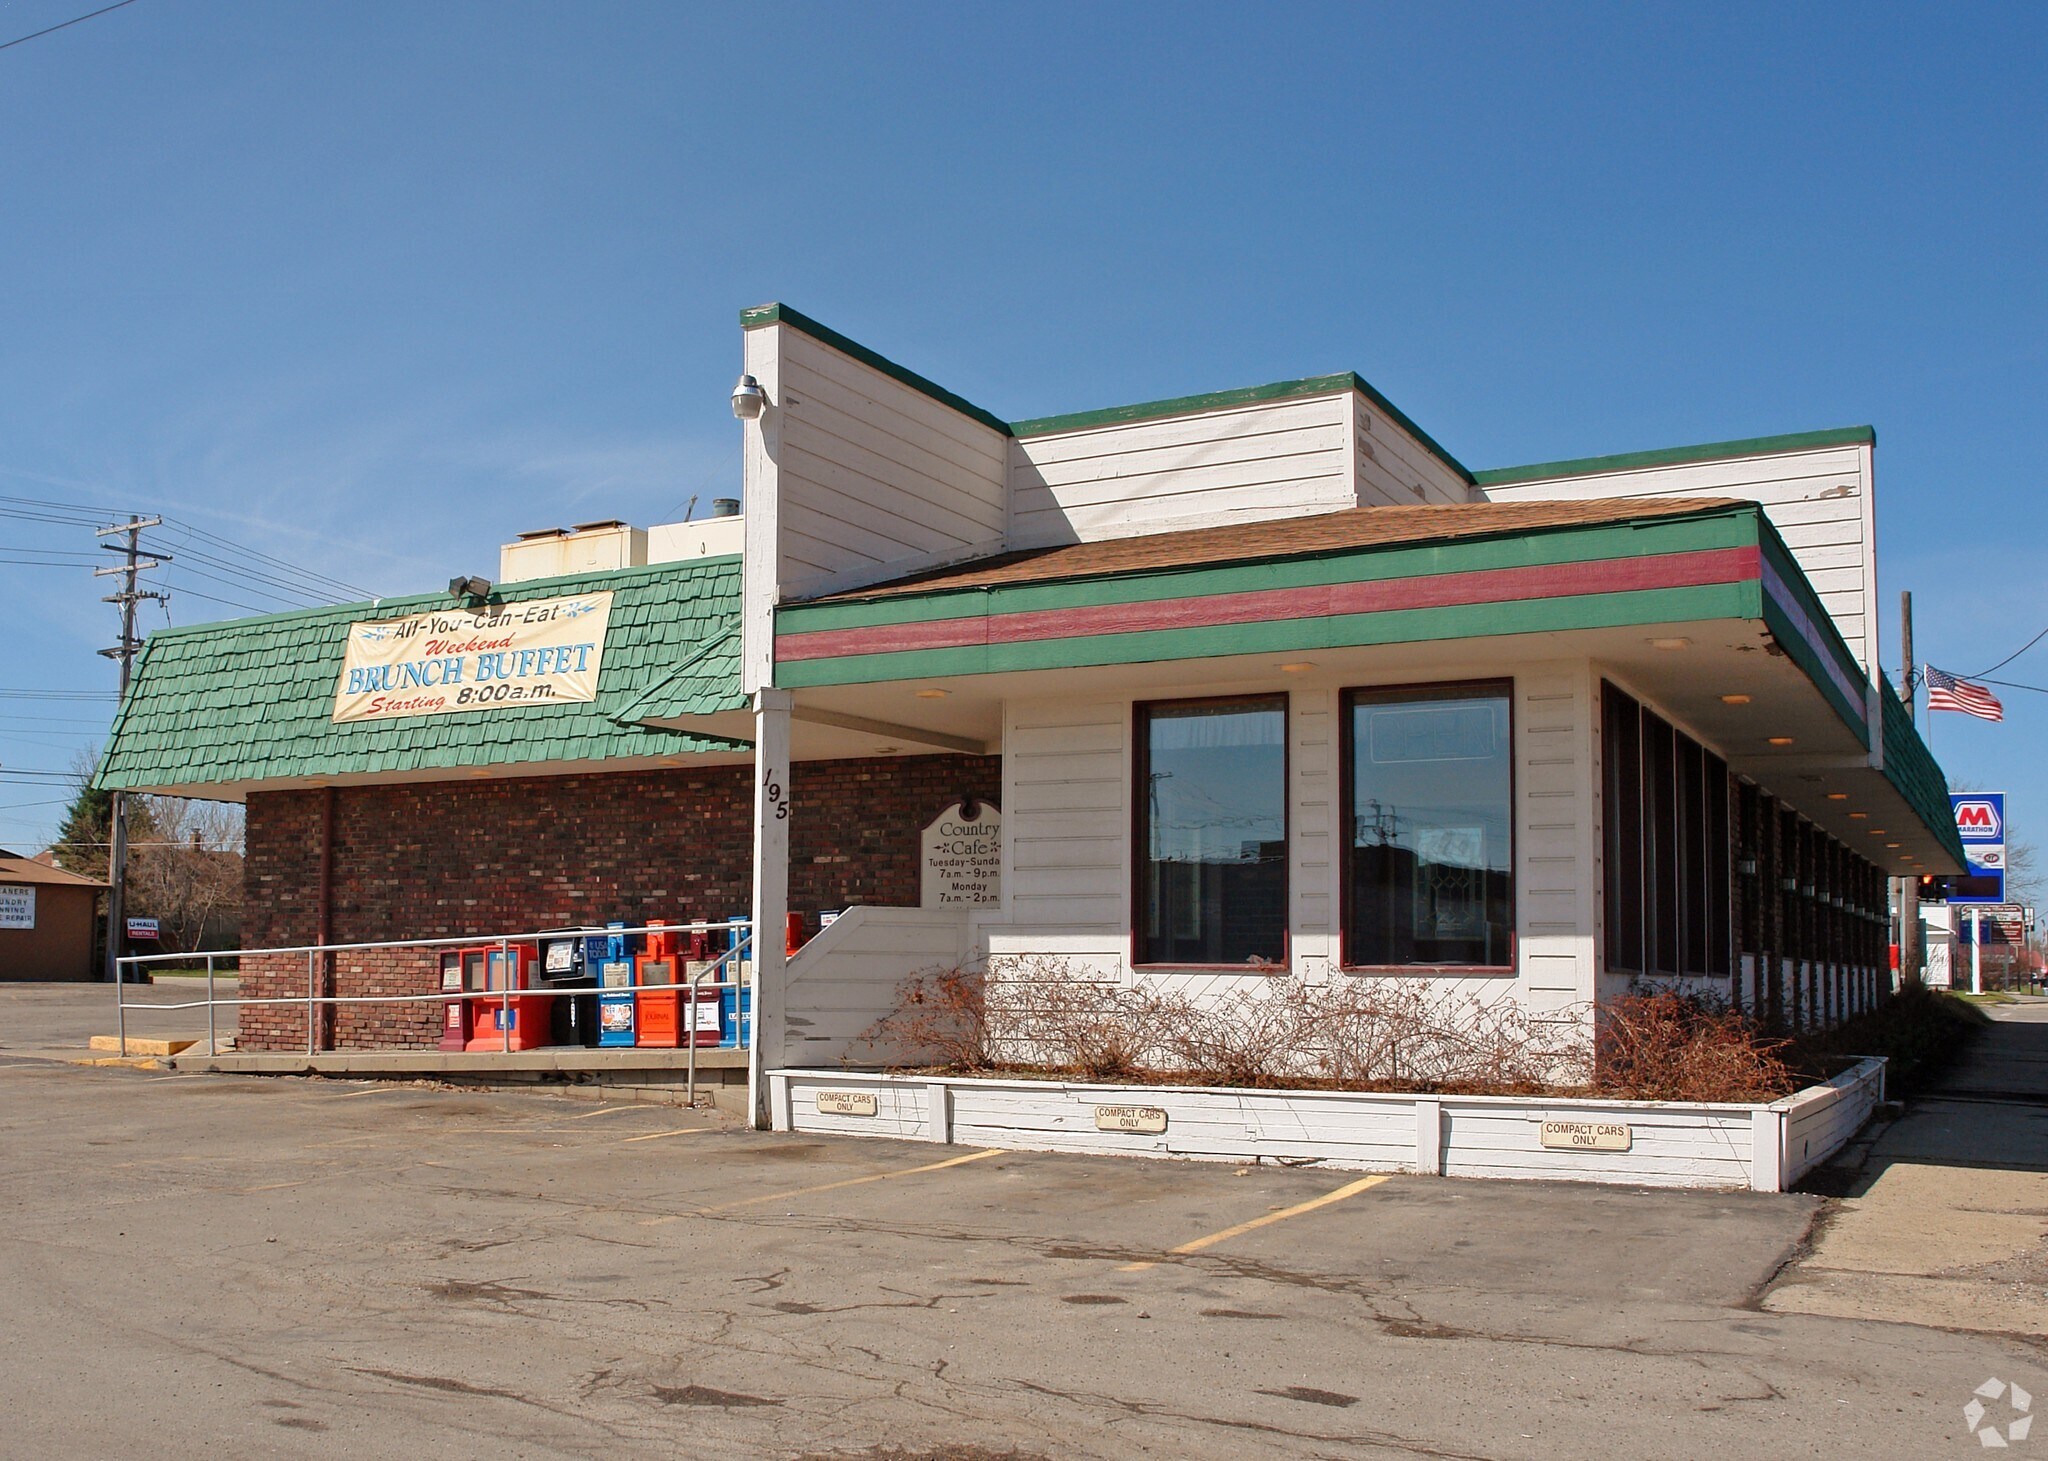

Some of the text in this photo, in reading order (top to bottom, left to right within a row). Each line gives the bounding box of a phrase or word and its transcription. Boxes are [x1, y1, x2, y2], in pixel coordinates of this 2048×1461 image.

[393, 604, 561, 640] All-You-Can-Eat
[425, 632, 516, 657] Weekend
[346, 643, 596, 694] BRUNCH BUFFET
[366, 683, 556, 715] Starting 8:00a.m.
[763, 768, 788, 820] 195
[1958, 807, 1992, 826] M
[940, 822, 1000, 840] Country
[951, 840, 988, 856] Cafe
[929, 857, 1000, 867] Tuesday-Sunda
[951, 882, 988, 892] Monday
[819, 1093, 872, 1104] COMPACT CARS
[836, 1103, 854, 1111] ONLY
[1099, 1108, 1161, 1120] COMPACT CARS
[1120, 1118, 1139, 1127] ONLY
[1546, 1123, 1625, 1136] COMPACT CARS
[1572, 1135, 1597, 1145] ONLY
